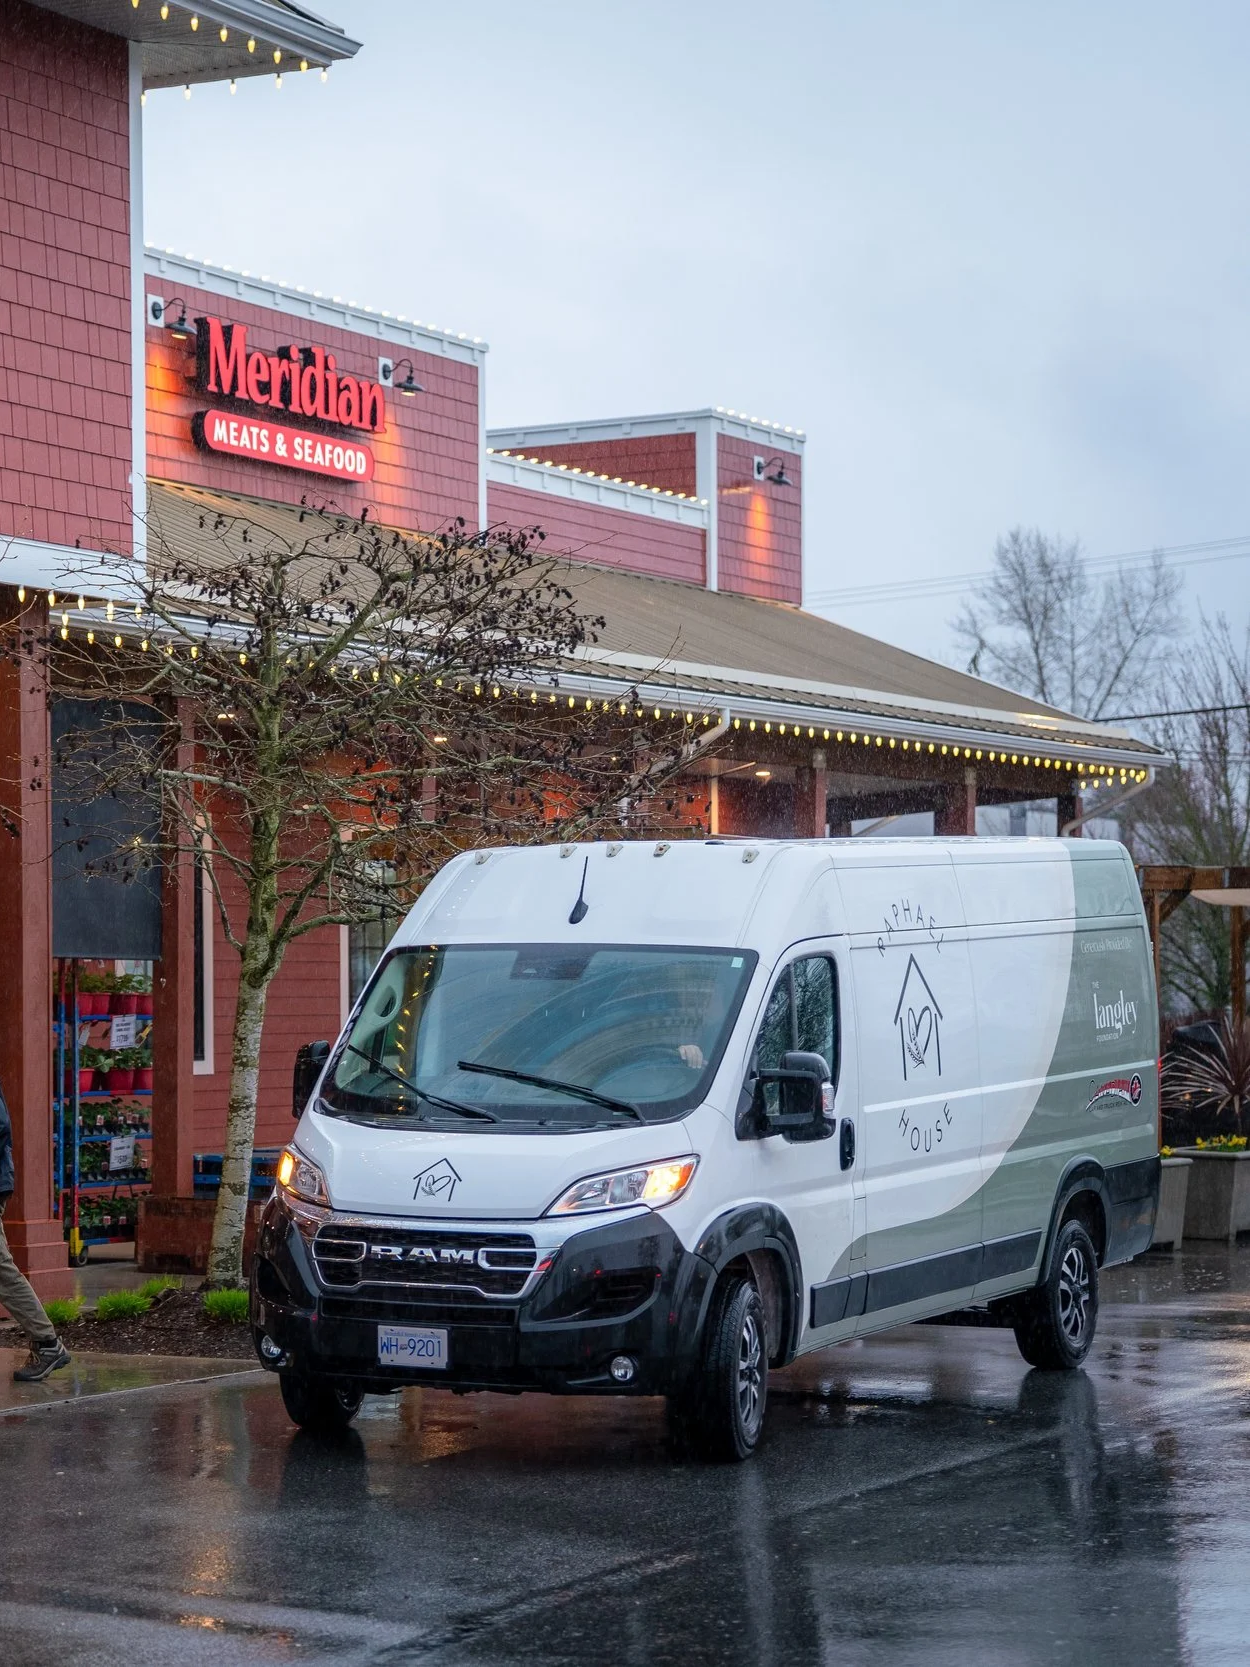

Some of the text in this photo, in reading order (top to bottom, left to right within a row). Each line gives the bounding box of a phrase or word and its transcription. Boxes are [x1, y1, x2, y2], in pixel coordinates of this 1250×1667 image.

[206, 316, 387, 433] Meridian
[213, 418, 367, 475] MEATS & SEAFOOD
[1093, 990, 1138, 1035] langley
[899, 1102, 953, 1153] HOUSE
[370, 1245, 474, 1264] RAM
[380, 1337, 441, 1357] WH 9201
